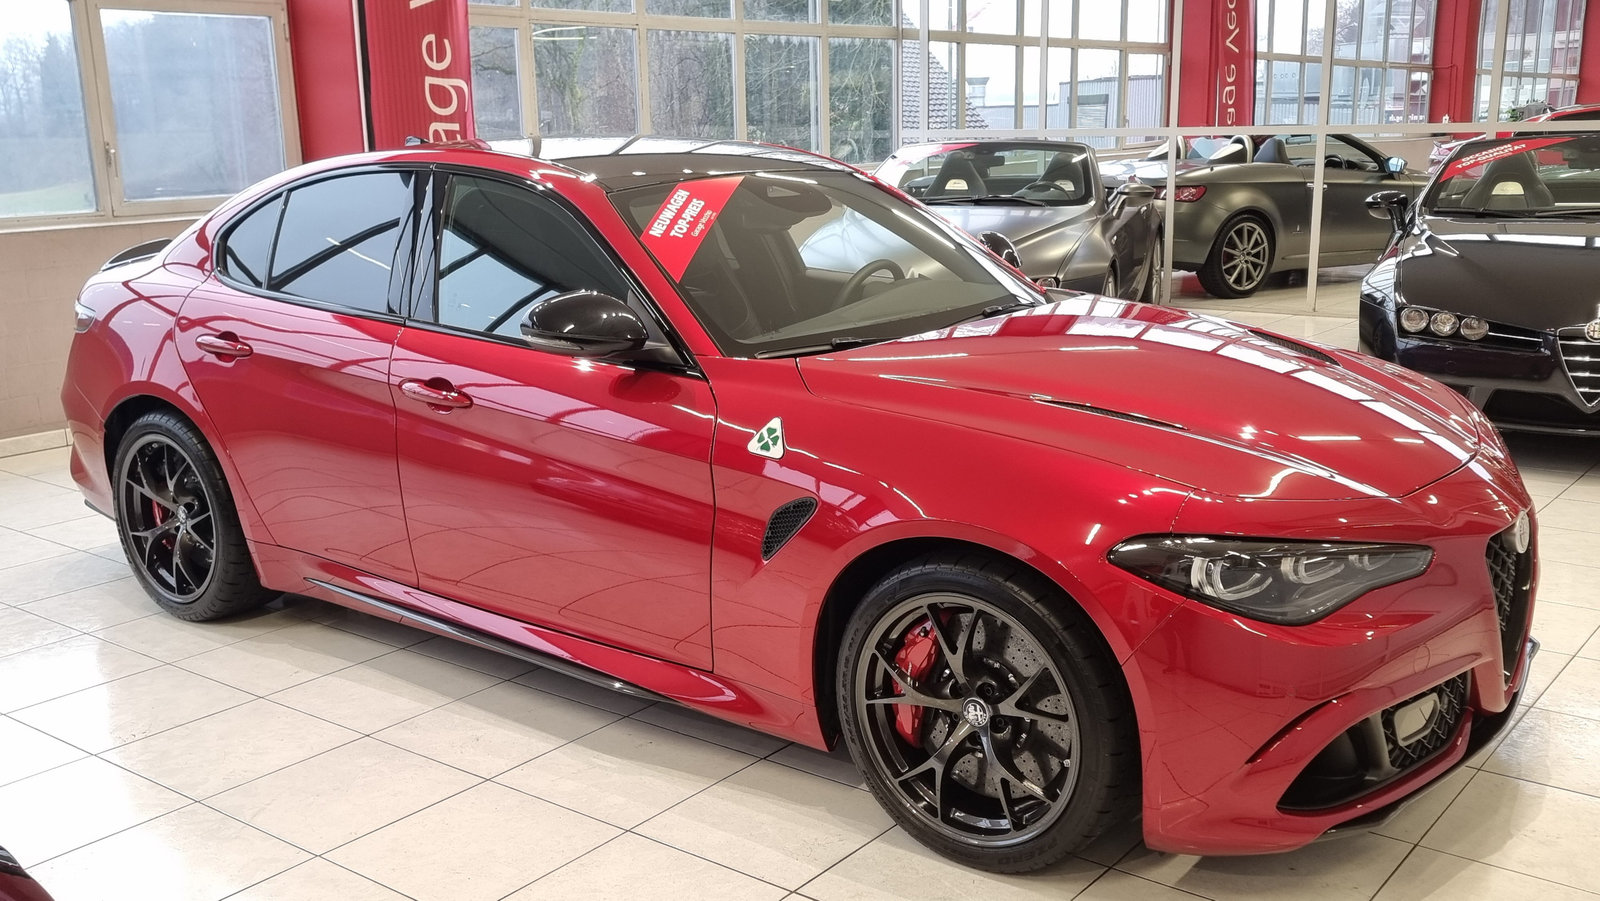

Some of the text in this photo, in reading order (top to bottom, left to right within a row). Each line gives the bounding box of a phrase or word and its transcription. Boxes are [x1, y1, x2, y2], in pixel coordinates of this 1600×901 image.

[421, 34, 468, 143] age
[1461, 143, 1513, 162] OCCASION
[648, 189, 691, 238] NEUWAGEN
[669, 198, 705, 238] TOP-PREIS
